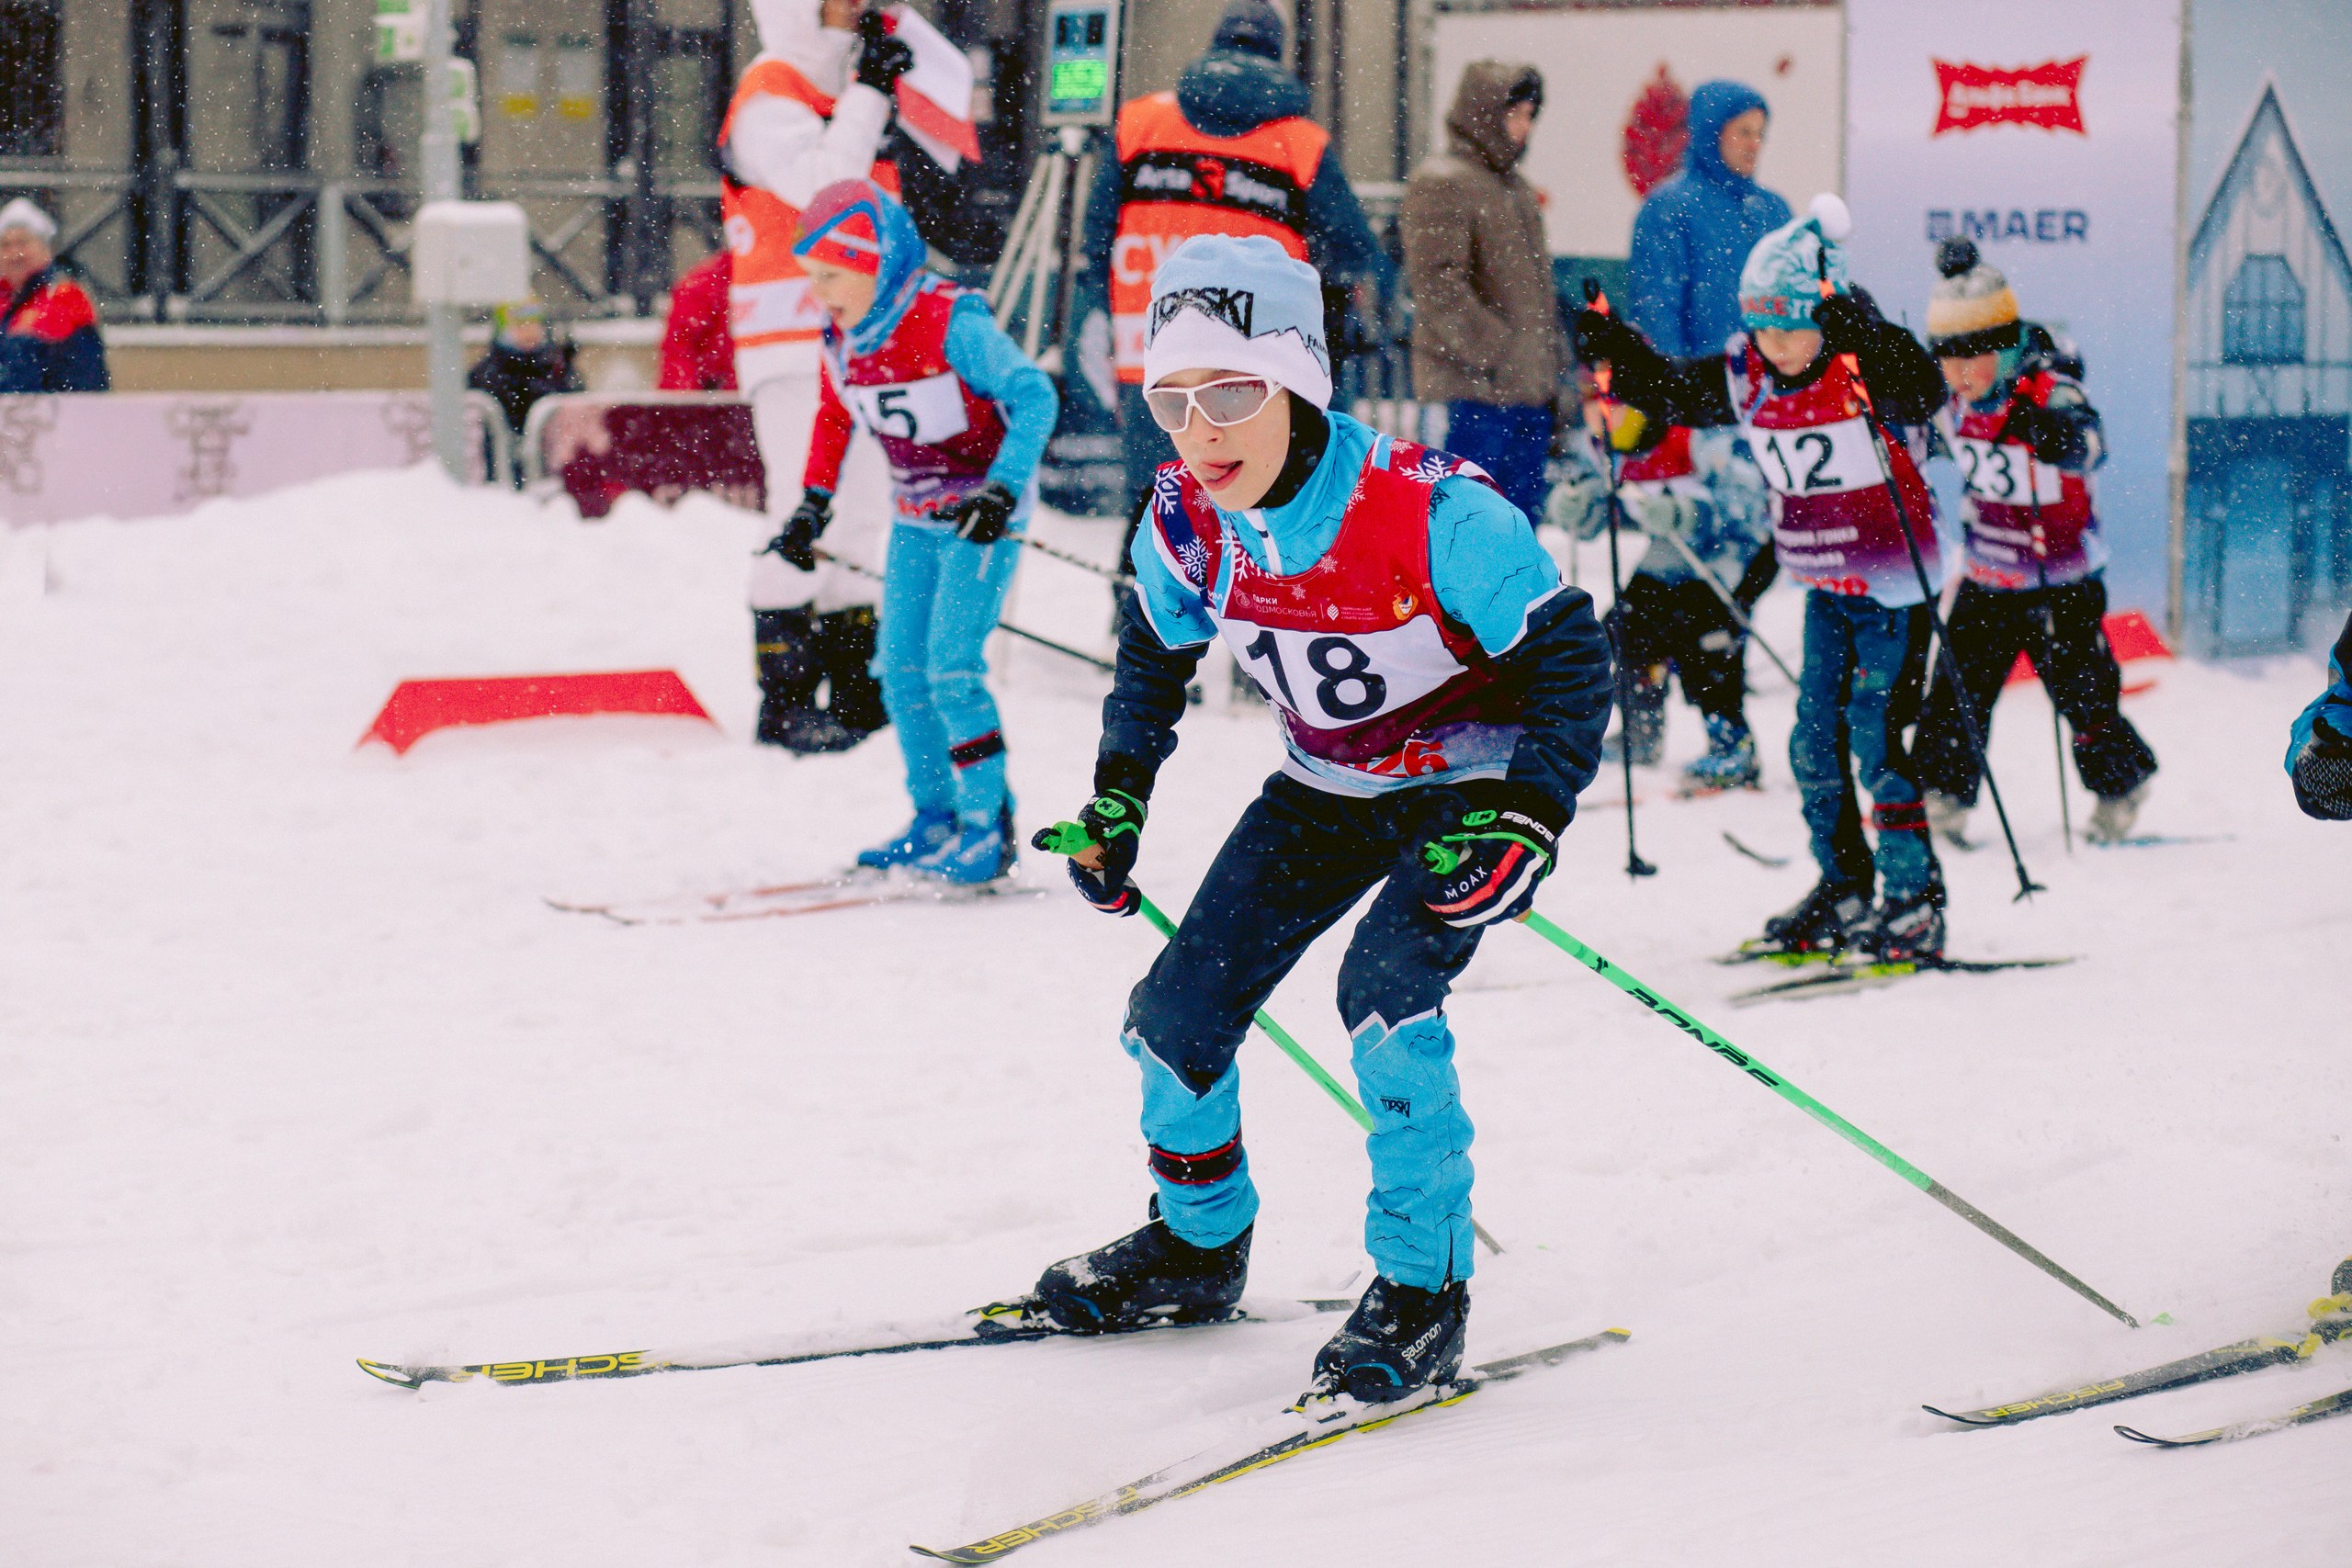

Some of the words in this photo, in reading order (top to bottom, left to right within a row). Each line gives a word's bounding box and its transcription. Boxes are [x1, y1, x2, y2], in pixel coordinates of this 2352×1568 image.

[1962, 209, 2088, 243] MAER
[1767, 433, 1842, 491] 12
[1962, 445, 2014, 498] 23
[1246, 630, 1386, 721] 18
[1444, 865, 1488, 900] MOAX
